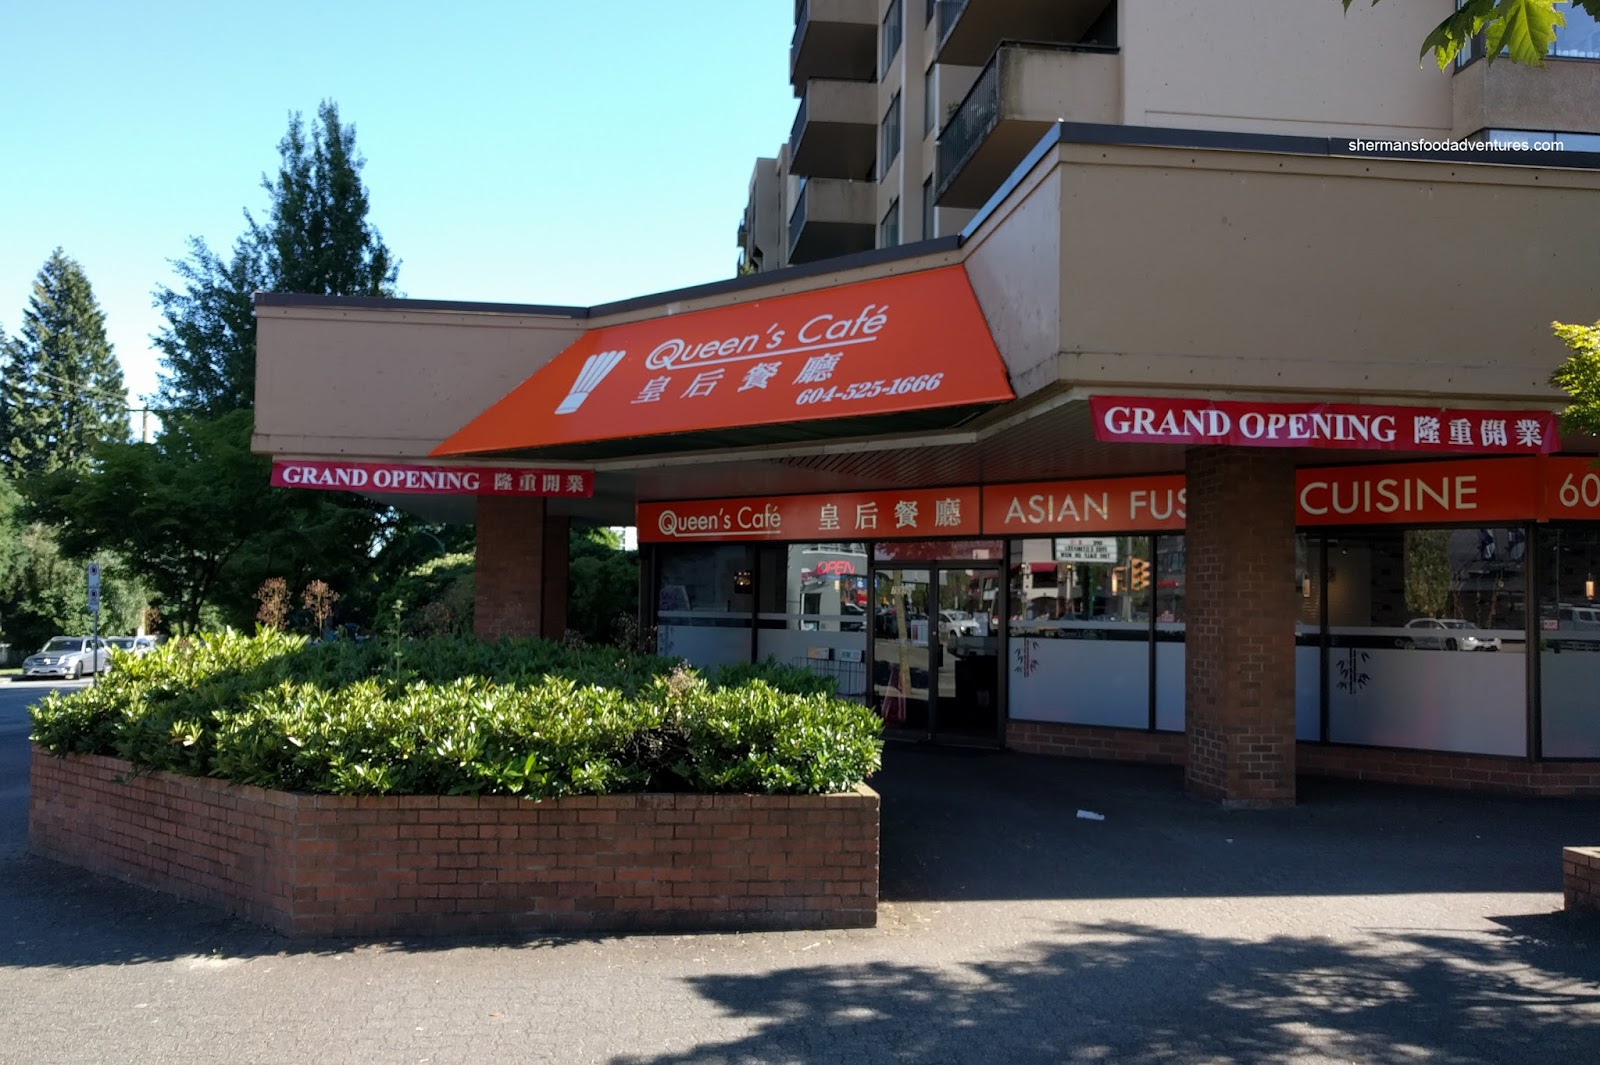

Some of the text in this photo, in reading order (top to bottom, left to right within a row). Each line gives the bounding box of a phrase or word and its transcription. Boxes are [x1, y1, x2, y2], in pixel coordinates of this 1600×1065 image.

[645, 304, 889, 371] Queen's Café
[631, 352, 844, 404] 皇后餐廳
[796, 372, 944, 406] 604-525-1666
[1104, 406, 1397, 443] GRAND OPENING
[1413, 415, 1543, 448] 隆重開業
[282, 465, 480, 490] GRAND OPENING
[494, 472, 585, 493] 隆重開業
[818, 498, 963, 531] 皇后餐廳
[1004, 492, 1109, 525] ASIAN
[1299, 475, 1478, 516] CUISINE
[658, 503, 782, 536] Queen's Café
[816, 560, 855, 576] OPEN
